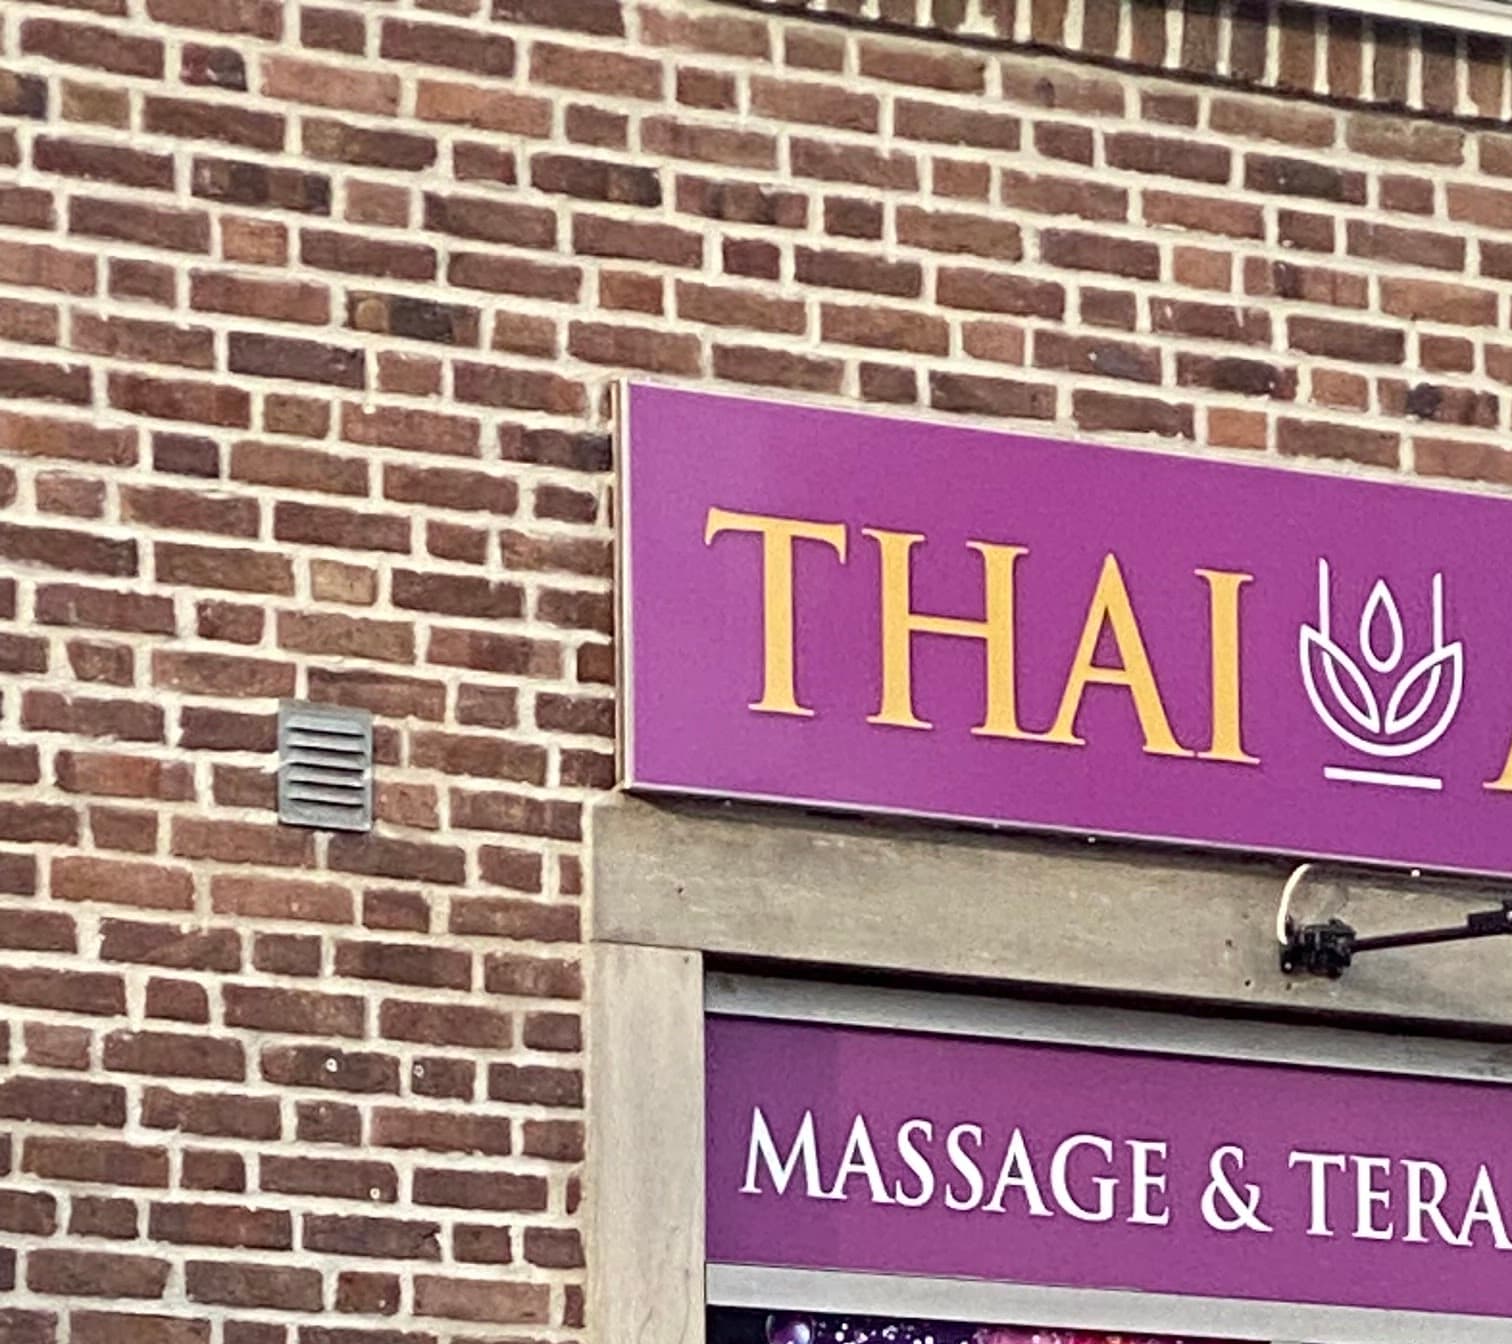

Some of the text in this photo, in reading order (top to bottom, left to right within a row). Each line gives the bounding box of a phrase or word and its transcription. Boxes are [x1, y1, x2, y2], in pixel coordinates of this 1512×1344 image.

[703, 505, 1262, 765] THAI
[740, 1105, 1170, 1226] MASSAGE
[1200, 1144, 1274, 1234] &
